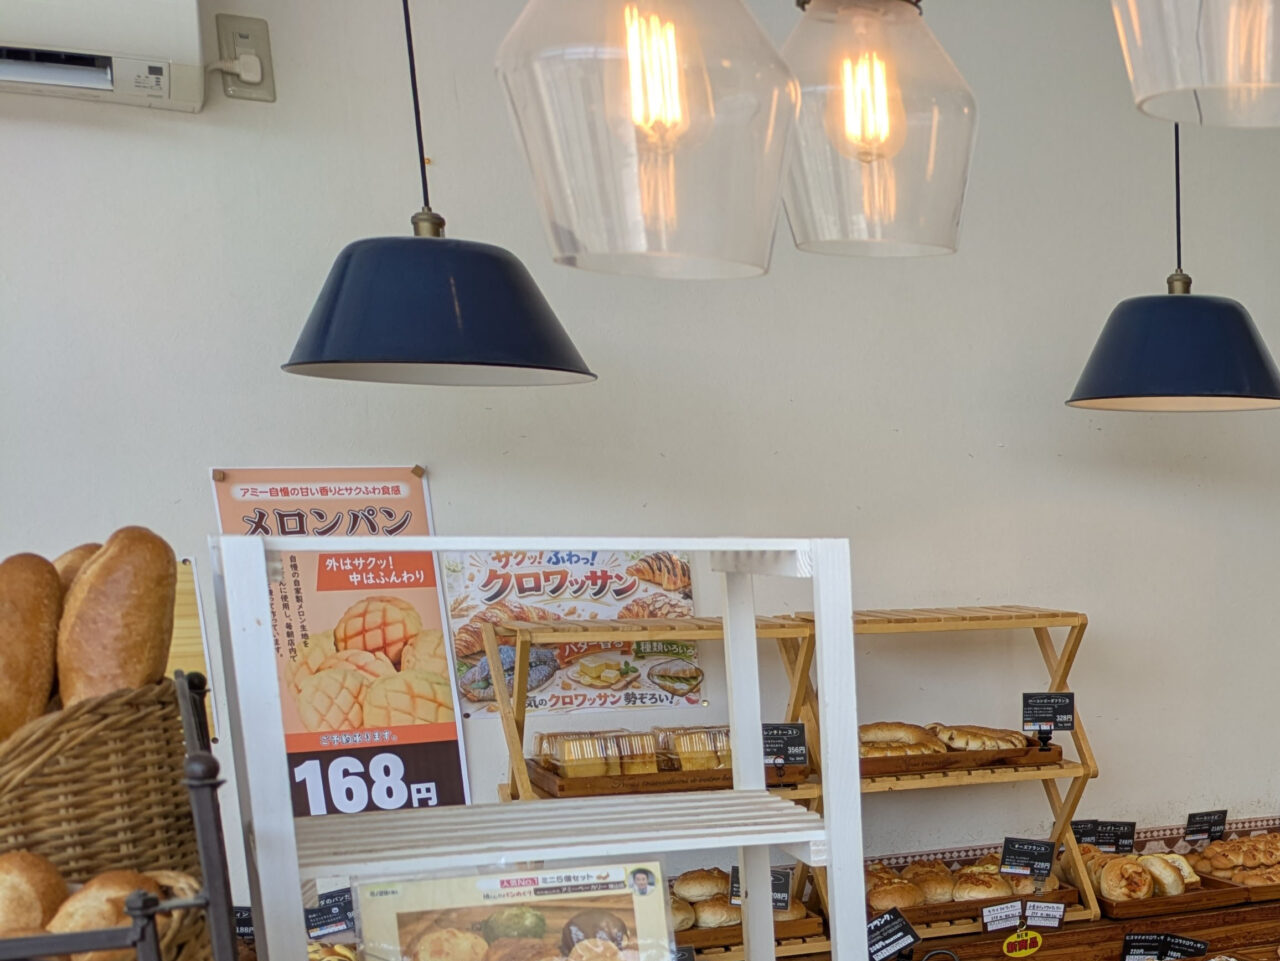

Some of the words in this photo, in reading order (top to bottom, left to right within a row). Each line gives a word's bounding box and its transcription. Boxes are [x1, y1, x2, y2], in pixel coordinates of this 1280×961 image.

[239, 484, 402, 498] アミー自慢の甘い香りとサクふわ食感
[243, 506, 413, 537] メロンパン
[325, 555, 394, 573] 外はサクッ！
[349, 569, 426, 585] 中はふんわり
[478, 568, 640, 604] クロワッサン
[294, 752, 438, 817] 168円
